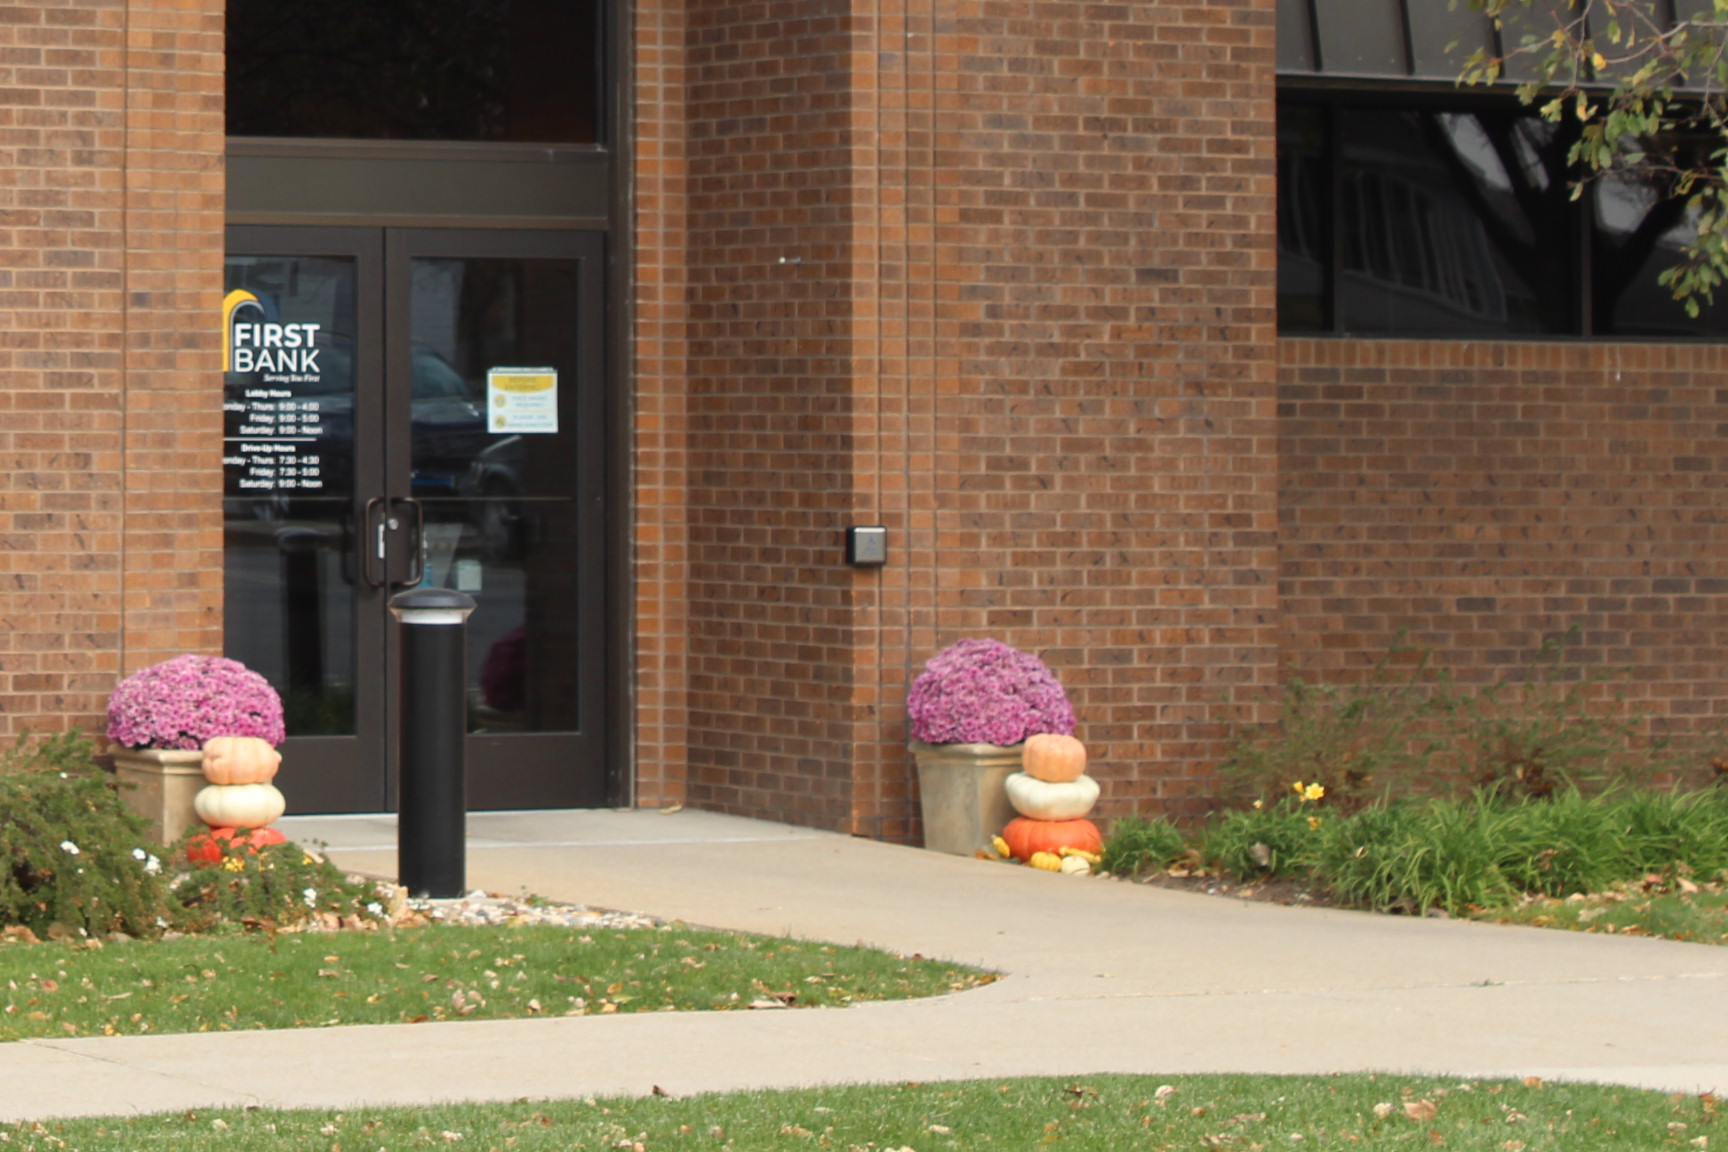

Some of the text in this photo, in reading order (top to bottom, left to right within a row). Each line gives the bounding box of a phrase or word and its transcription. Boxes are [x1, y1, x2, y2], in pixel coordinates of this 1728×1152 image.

[234, 323, 320, 348] FIRST
[234, 349, 320, 373] BANK
[264, 374, 290, 383] Serving
[304, 374, 320, 382] First
[245, 389, 292, 399] Lobby Hours
[222, 402, 246, 412] onday
[278, 402, 297, 411] 9:00
[301, 402, 320, 411] 4:00
[301, 426, 323, 434] Noon
[274, 444, 296, 452] Hours
[222, 456, 246, 466] onday
[278, 456, 297, 464] 7:30
[301, 456, 320, 464] 4:30
[278, 467, 297, 476] 7:30
[301, 479, 323, 488] Noon
